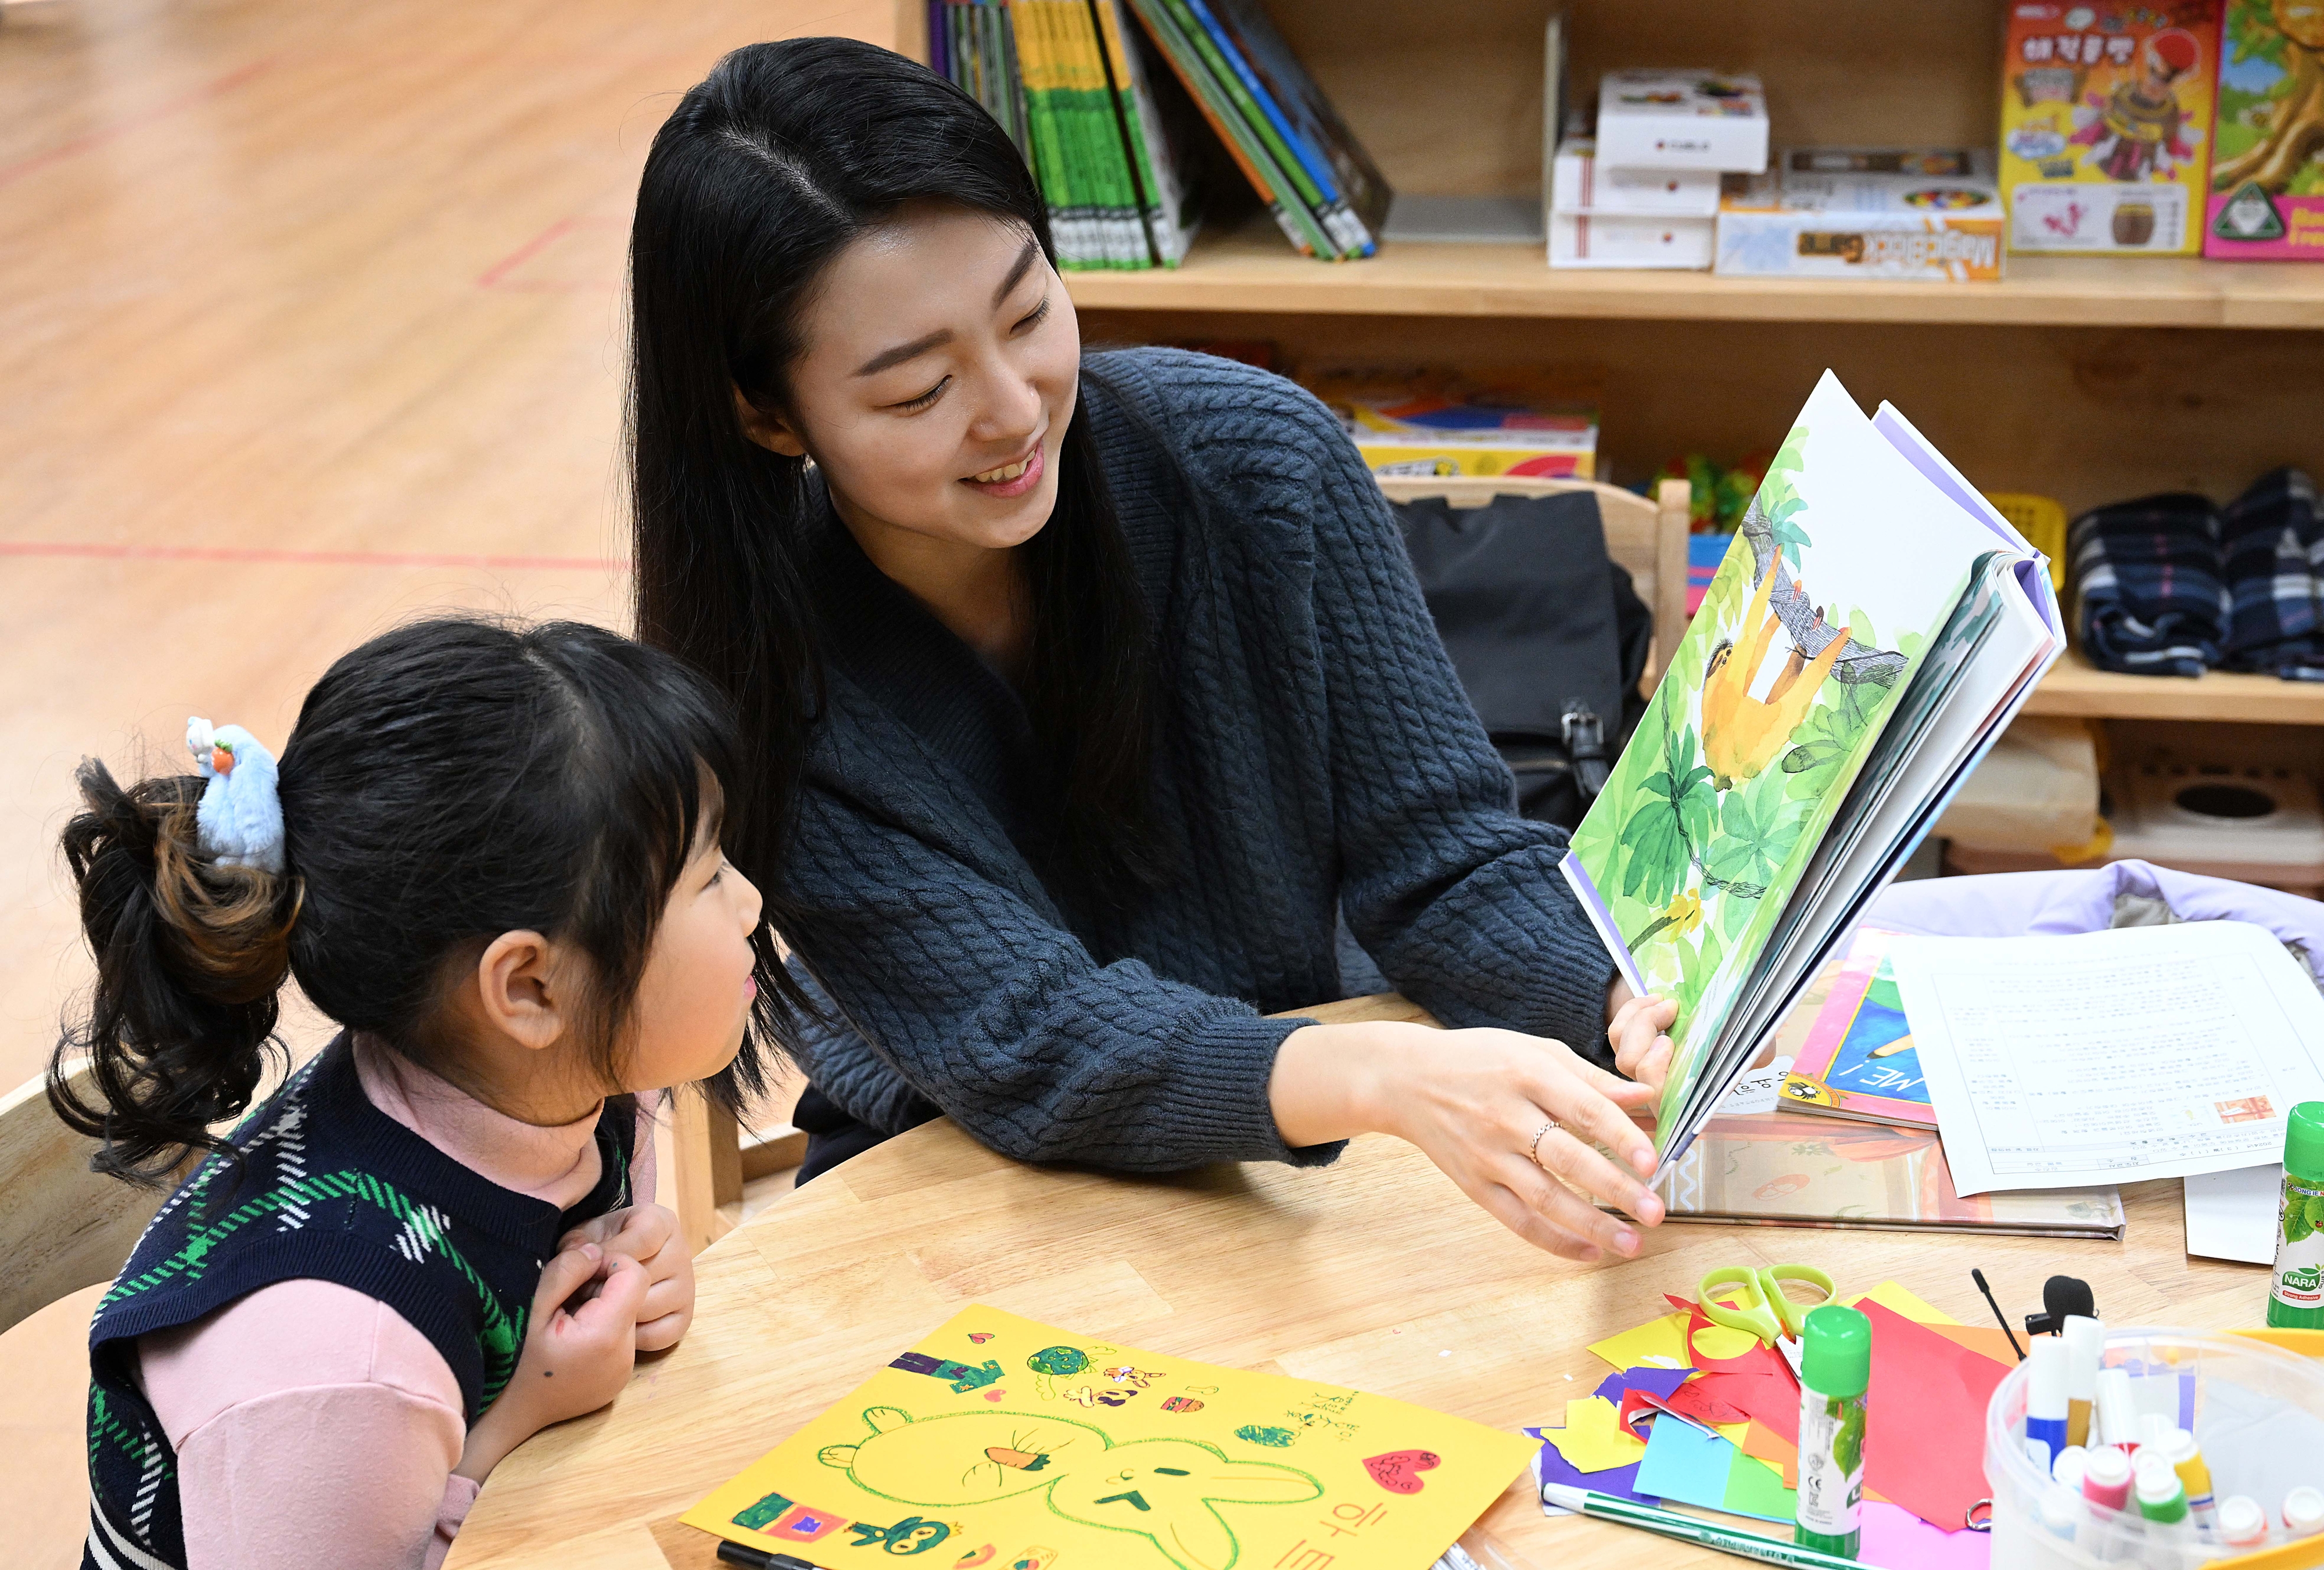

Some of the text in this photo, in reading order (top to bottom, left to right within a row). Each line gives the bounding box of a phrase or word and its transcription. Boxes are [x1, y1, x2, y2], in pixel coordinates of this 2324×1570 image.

[2294, 1187, 2311, 1195] JONG
[2284, 1274, 2316, 1288] NARA
[2284, 1291, 2298, 1299] Strong
